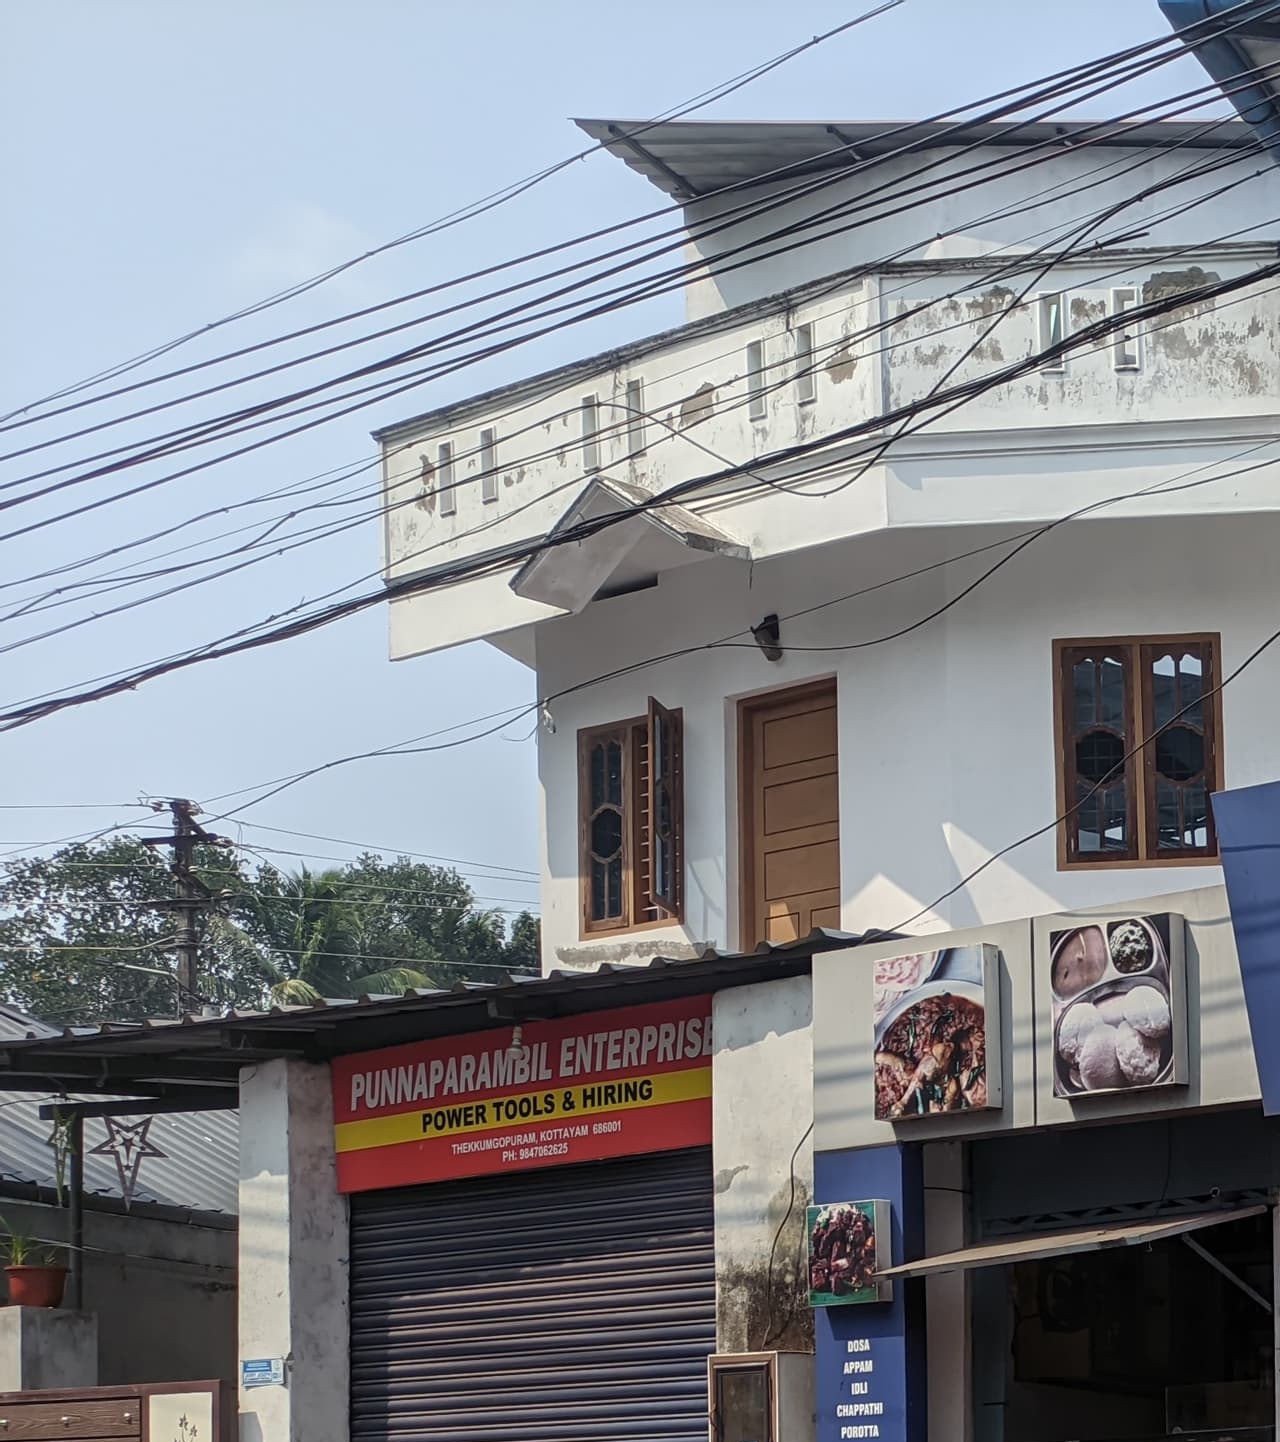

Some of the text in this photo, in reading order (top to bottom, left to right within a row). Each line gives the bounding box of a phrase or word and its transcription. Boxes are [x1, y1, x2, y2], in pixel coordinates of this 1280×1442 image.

[351, 1043, 551, 1111] PUNNAPARAMBIL
[422, 1079, 653, 1133] POWER TOOLS & HIRING
[540, 1124, 589, 1143] KOTTAYAM
[592, 1120, 622, 1135] 686001
[502, 1147, 517, 1162] PH:
[847, 1339, 870, 1353] DOSA
[843, 1360, 873, 1375] APPAM
[851, 1382, 868, 1395] IDLI
[836, 1402, 884, 1418] CHAPPATHI
[841, 1424, 879, 1439] POROTTA
